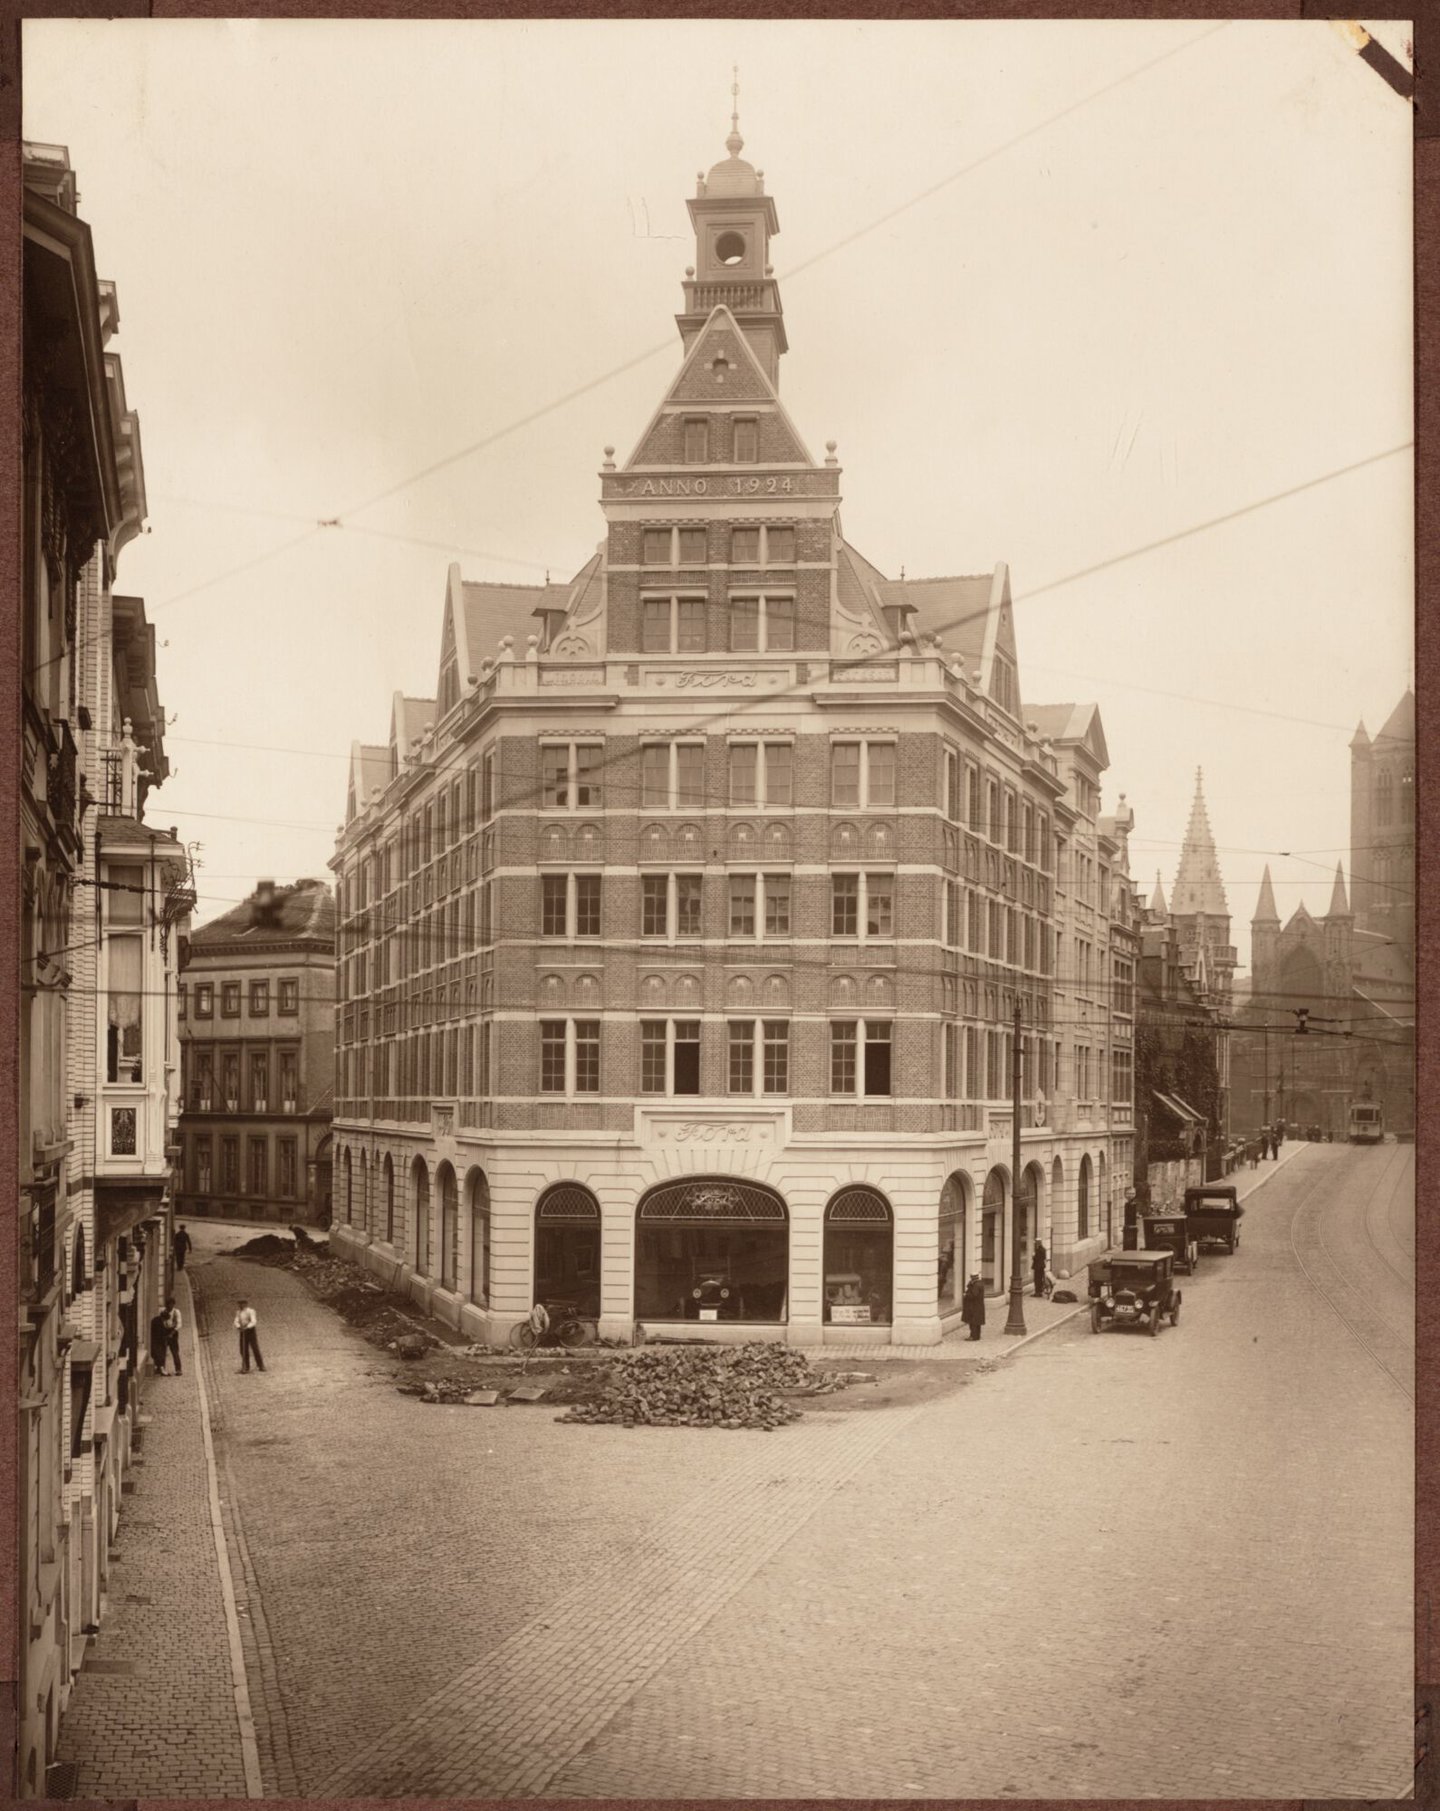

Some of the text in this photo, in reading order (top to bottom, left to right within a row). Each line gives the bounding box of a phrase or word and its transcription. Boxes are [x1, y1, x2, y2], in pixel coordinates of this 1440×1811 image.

[641, 478, 793, 495] ANNO 1924
[676, 670, 757, 688] Ford
[674, 1121, 751, 1142] Ford
